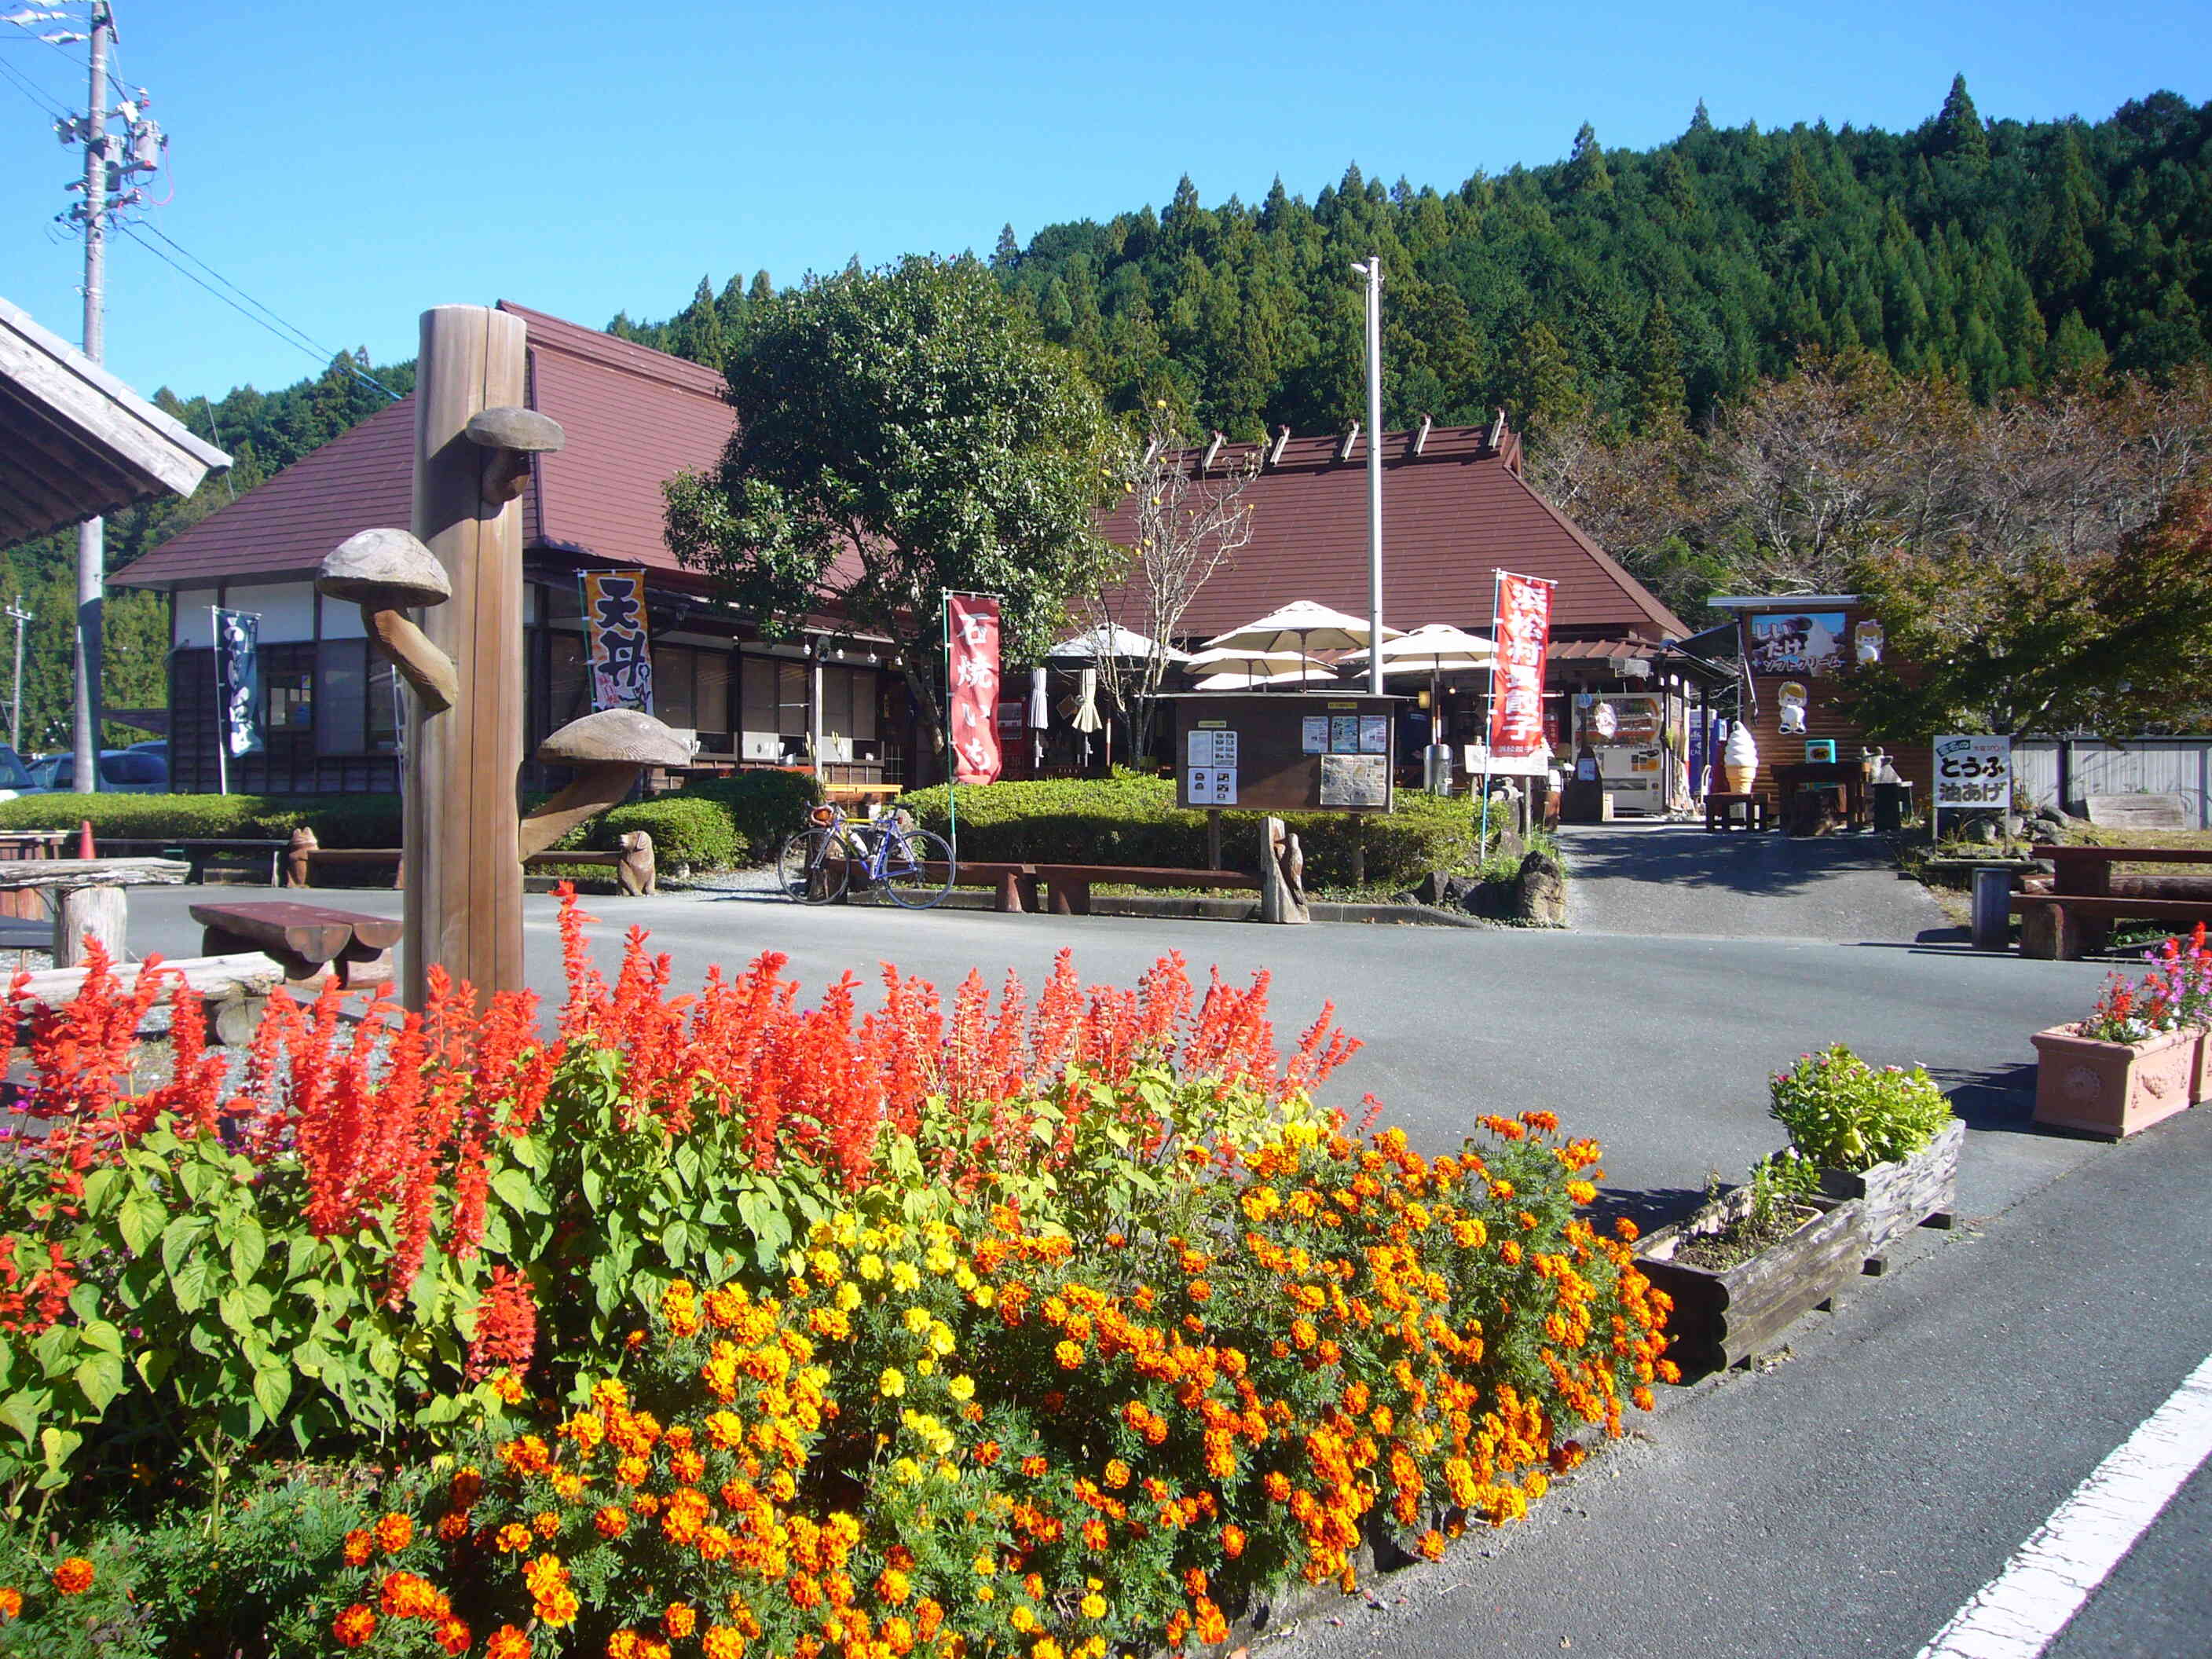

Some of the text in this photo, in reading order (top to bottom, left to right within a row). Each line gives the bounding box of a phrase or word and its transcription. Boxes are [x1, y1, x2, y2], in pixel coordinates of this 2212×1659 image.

[596, 578, 646, 687] 天丼
[1756, 623, 1789, 639] しい
[1767, 639, 1800, 657] たけ
[1764, 657, 1842, 672] ソフトクリーム
[956, 613, 993, 771] 石焼いも
[1941, 756, 2005, 778] とうふ
[1939, 782, 2007, 802] 油あげ
